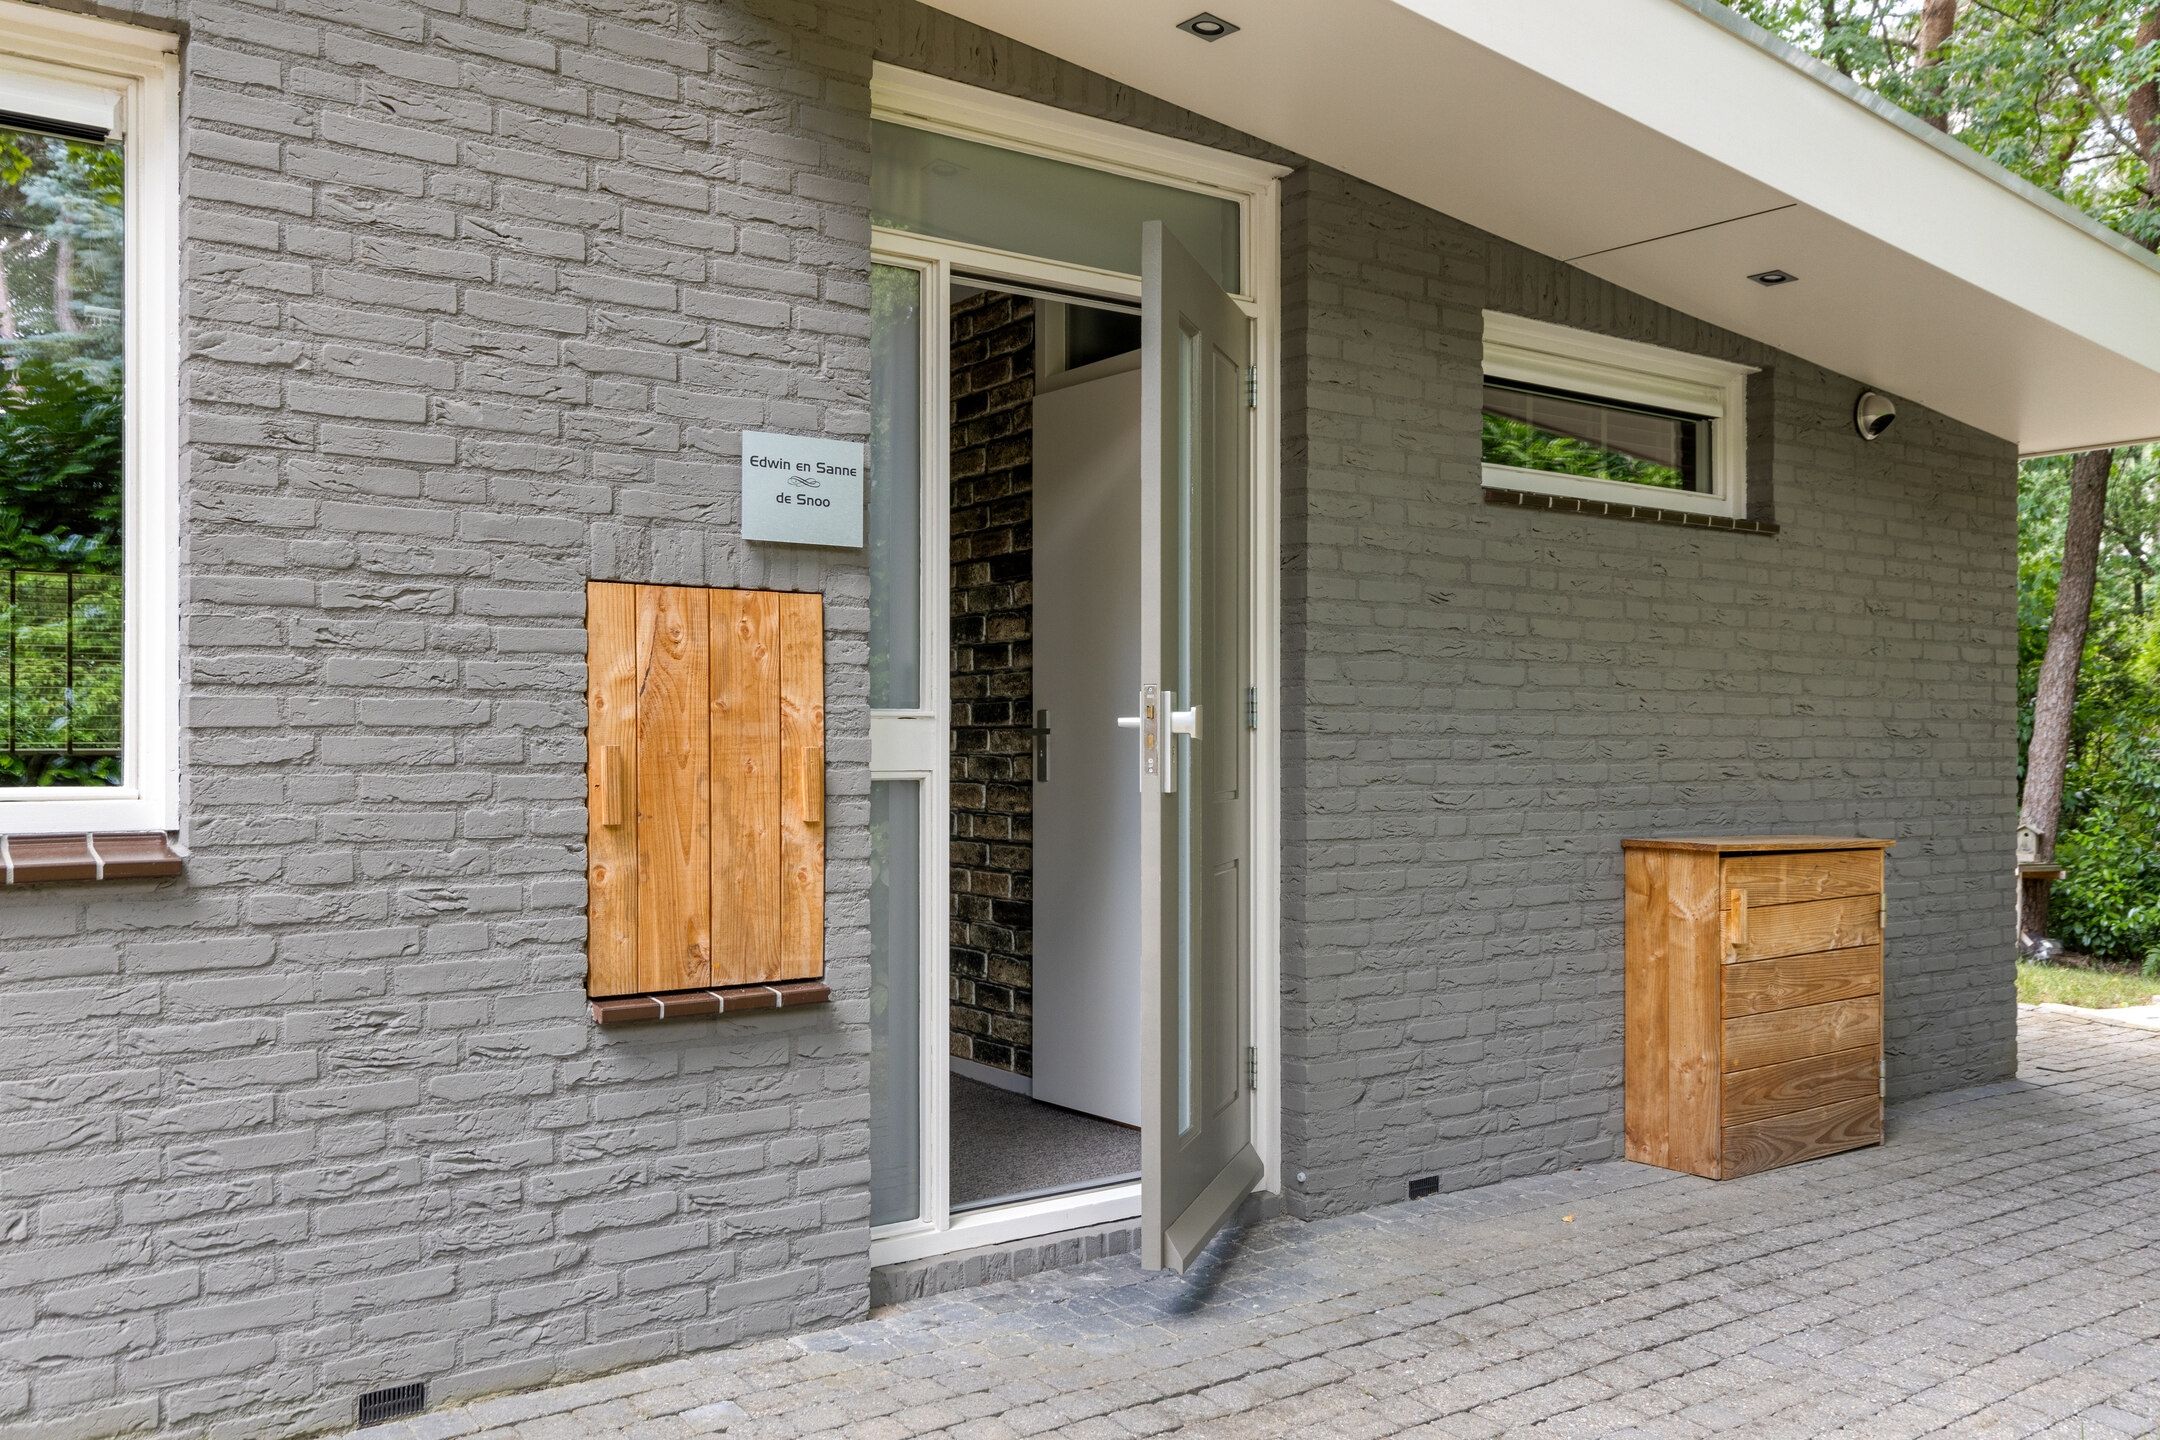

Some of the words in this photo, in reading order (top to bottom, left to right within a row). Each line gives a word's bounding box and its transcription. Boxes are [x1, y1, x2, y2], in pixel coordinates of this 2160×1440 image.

[750, 455, 790, 470] Edwin
[796, 462, 811, 472] en
[816, 462, 857, 477] Sanne
[776, 492, 791, 504] de
[796, 494, 831, 507] Snoo
